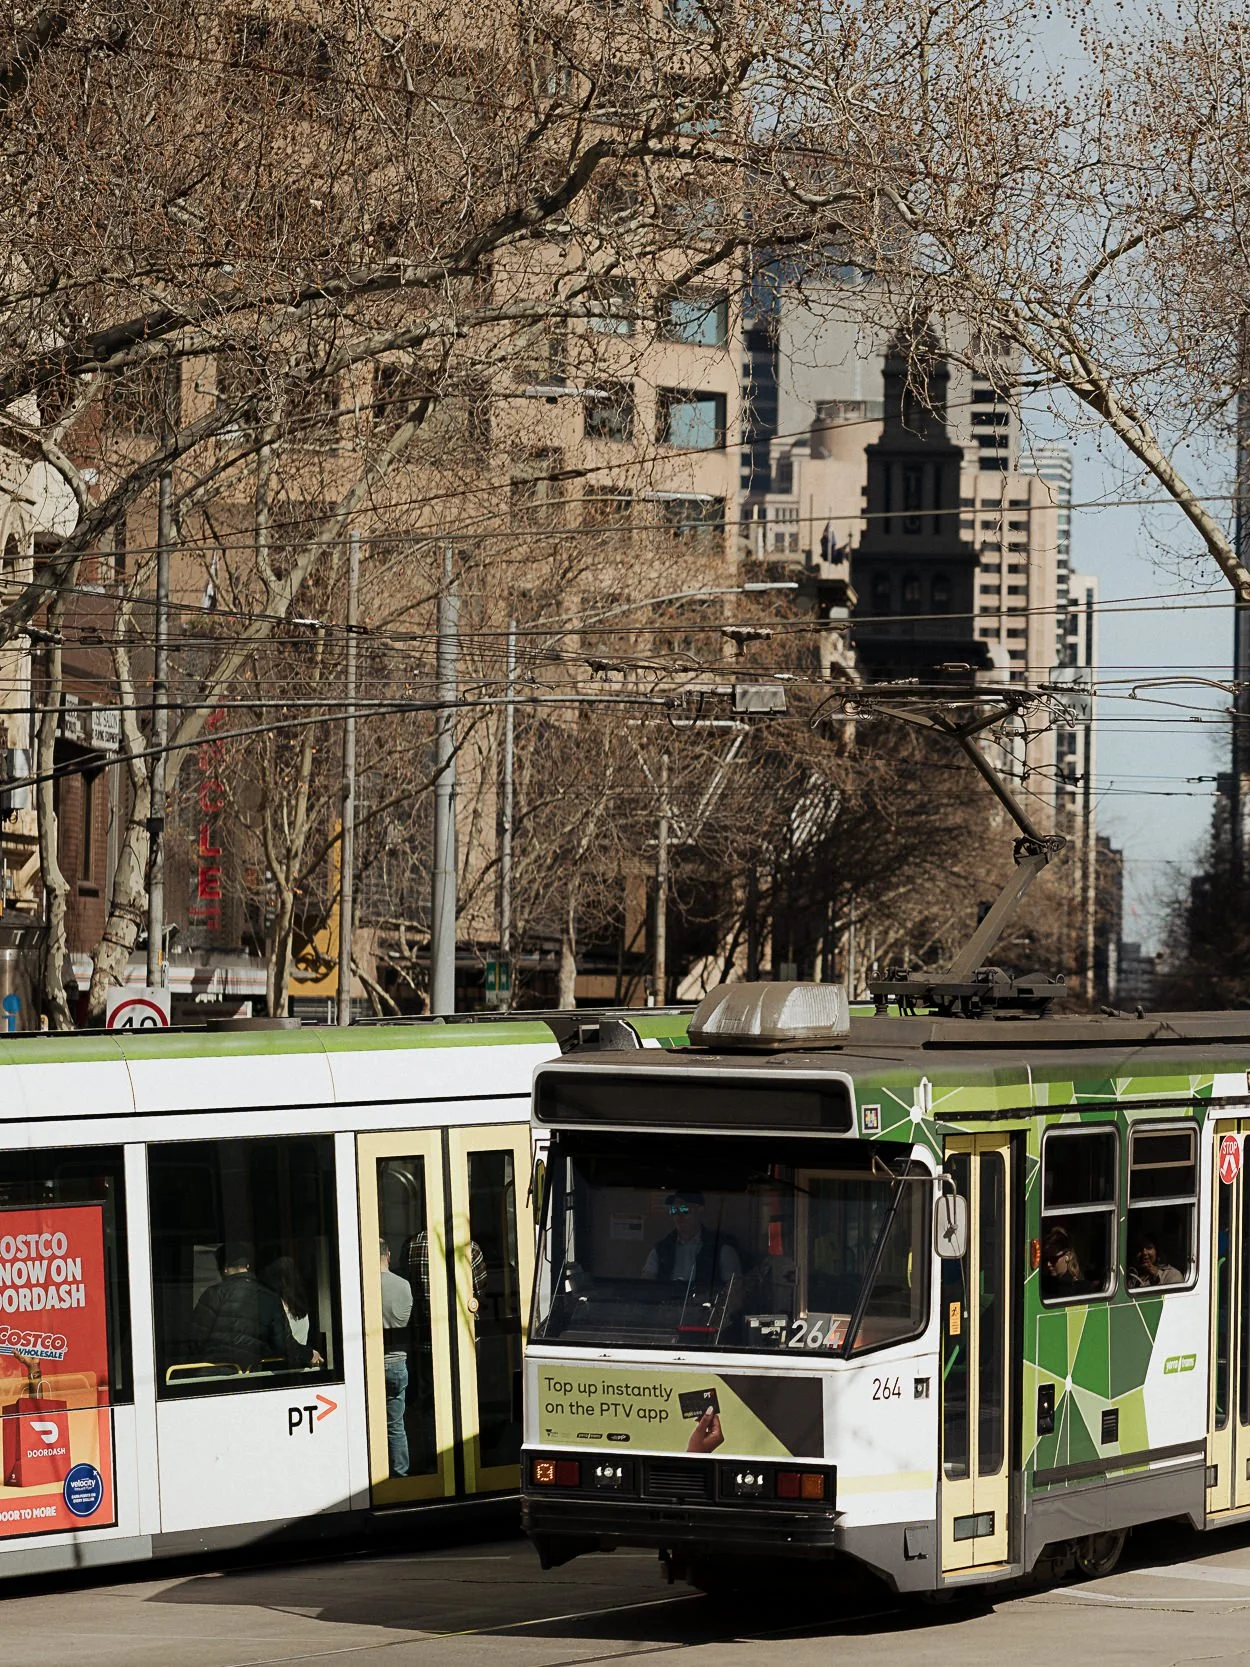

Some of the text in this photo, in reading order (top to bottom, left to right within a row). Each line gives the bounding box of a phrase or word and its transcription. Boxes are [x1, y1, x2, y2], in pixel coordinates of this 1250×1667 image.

[1223, 1141, 1238, 1154] STOP
[0, 1232, 68, 1260] OSTCO
[51, 1257, 82, 1283] ON
[0, 1284, 86, 1314] ORDASH
[788, 1319, 841, 1348] 264
[15, 1348, 64, 1360] WHOLESALE
[544, 1376, 673, 1402] Top up instantly
[872, 1376, 901, 1401] 264
[545, 1402, 565, 1415] on
[569, 1401, 595, 1416] the
[600, 1402, 634, 1418] PTV
[636, 1407, 669, 1424] app
[27, 1447, 66, 1458] DOORDASH
[70, 1479, 96, 1489] velocity
[0, 1505, 57, 1521] OOR TO MORE
